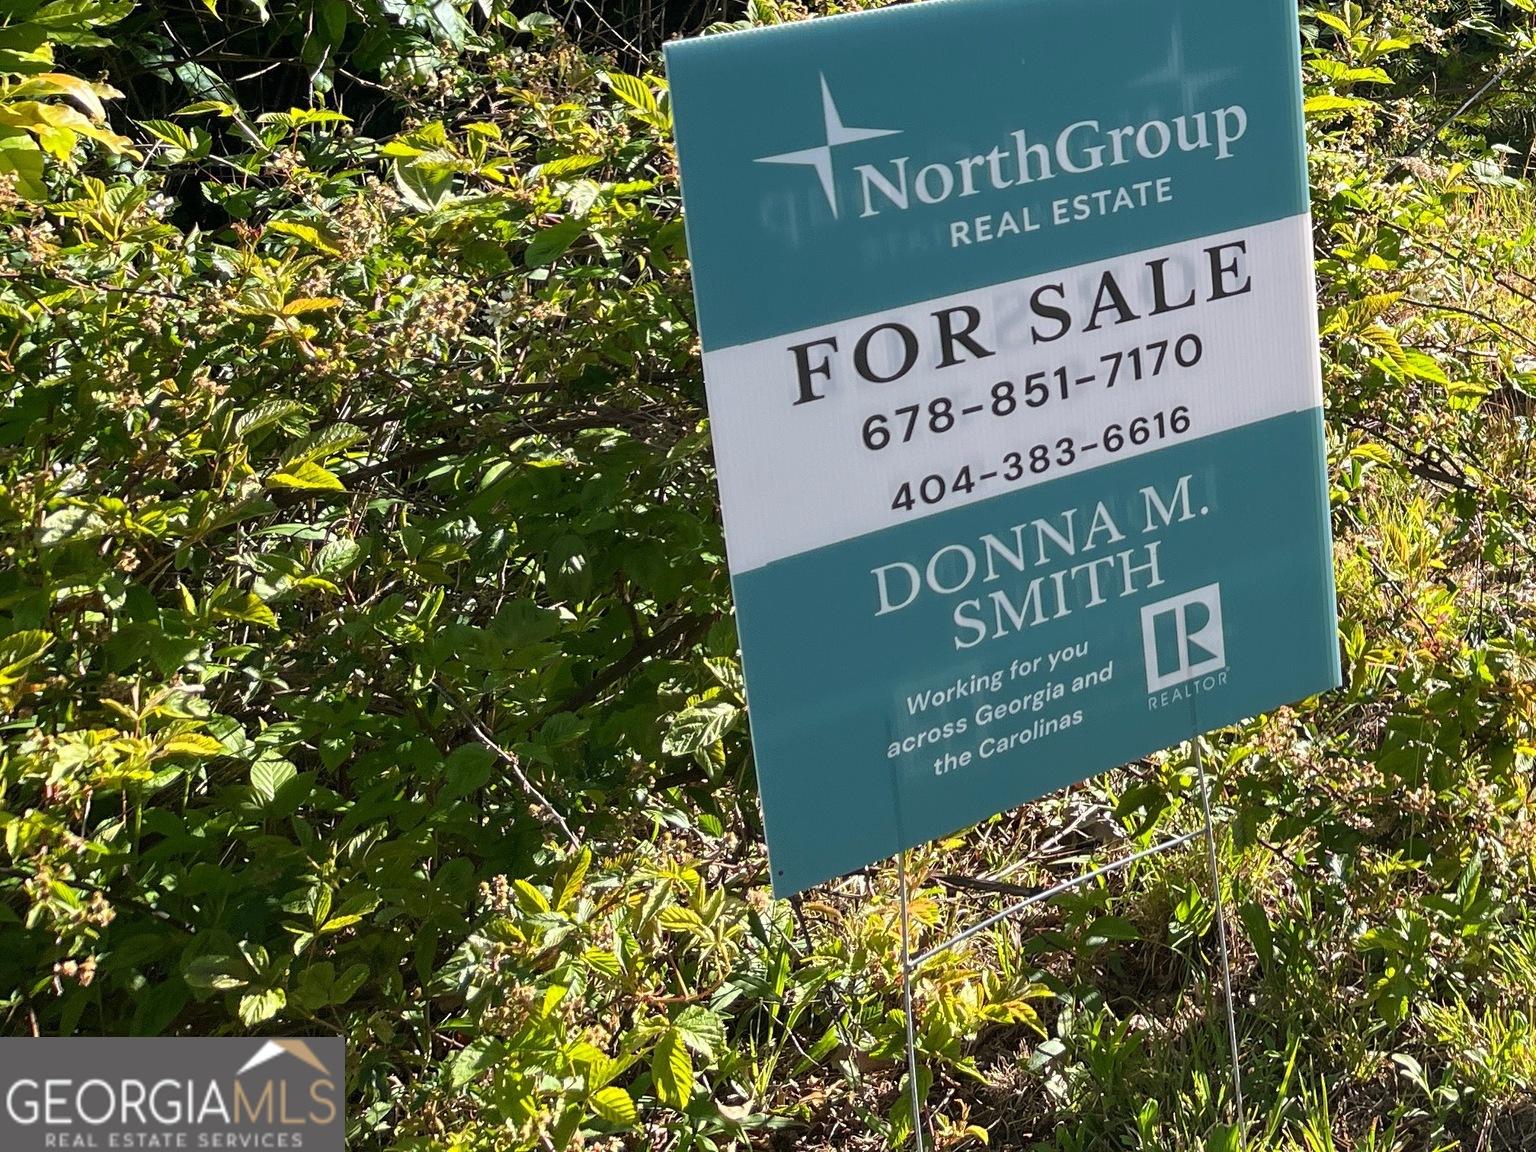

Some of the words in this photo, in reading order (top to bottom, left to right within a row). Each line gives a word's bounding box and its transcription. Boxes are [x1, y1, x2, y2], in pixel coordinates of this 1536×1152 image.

[853, 102, 1248, 218] NorthGroup
[950, 209, 1040, 248] REAL
[1052, 177, 1174, 226] ESTATE
[787, 305, 993, 406] FOR
[1029, 240, 1252, 344] SALE
[862, 333, 1203, 452] 678-851-7170
[892, 405, 1192, 512] 404-383-6616
[870, 501, 1126, 617] DONNA
[1138, 474, 1209, 528] M.
[953, 540, 1165, 649] SMITH
[886, 719, 969, 759] across
[975, 686, 1066, 726] Georgia
[1072, 661, 1114, 694] and
[906, 668, 1004, 716] Working
[1010, 653, 1042, 683] for
[1048, 638, 1089, 673] you
[1147, 672, 1228, 711] REALTOR
[933, 749, 972, 777] the
[978, 708, 1084, 759] Carolinas
